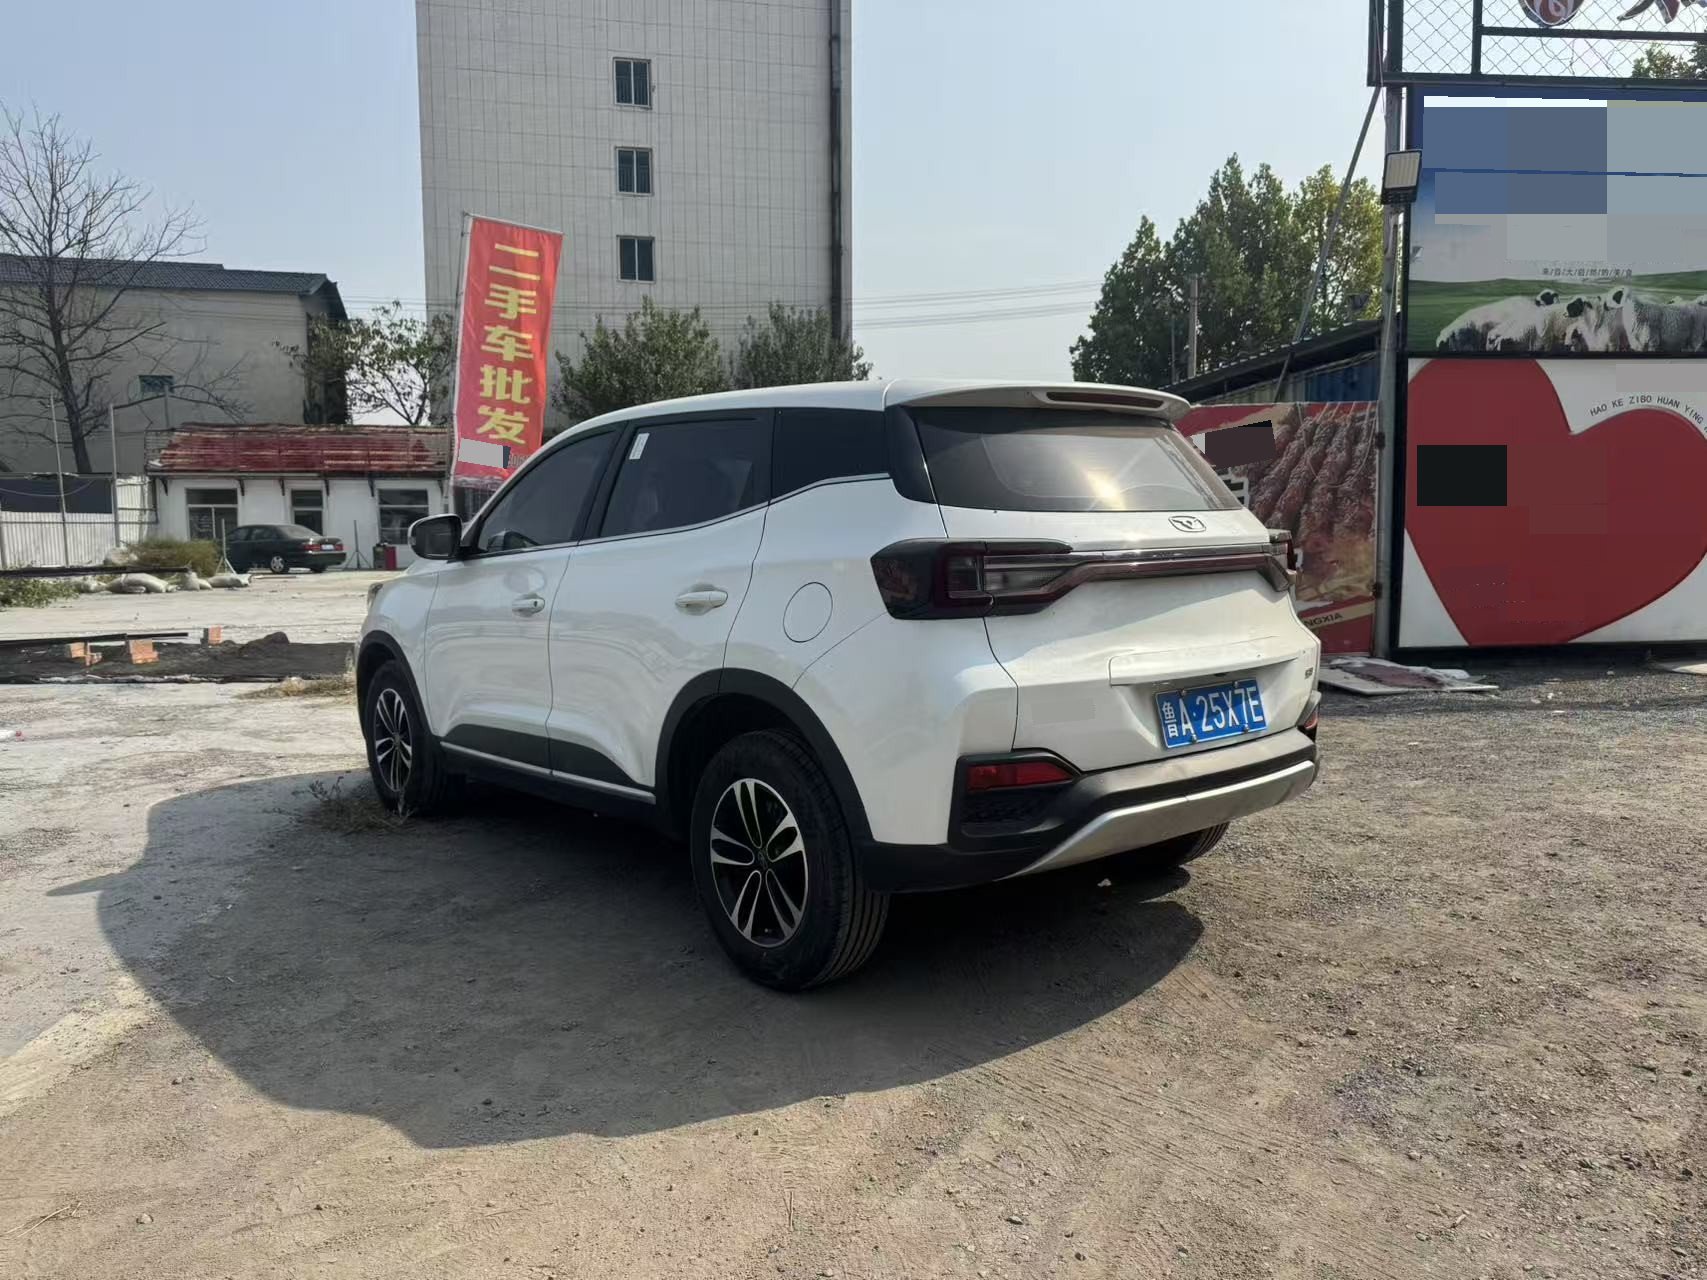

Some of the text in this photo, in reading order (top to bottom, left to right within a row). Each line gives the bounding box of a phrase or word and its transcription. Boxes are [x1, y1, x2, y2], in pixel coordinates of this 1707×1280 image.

[475, 242, 541, 446] 二手车批发
[1589, 394, 1704, 425] HAO KE ZIBO HUAN YING
